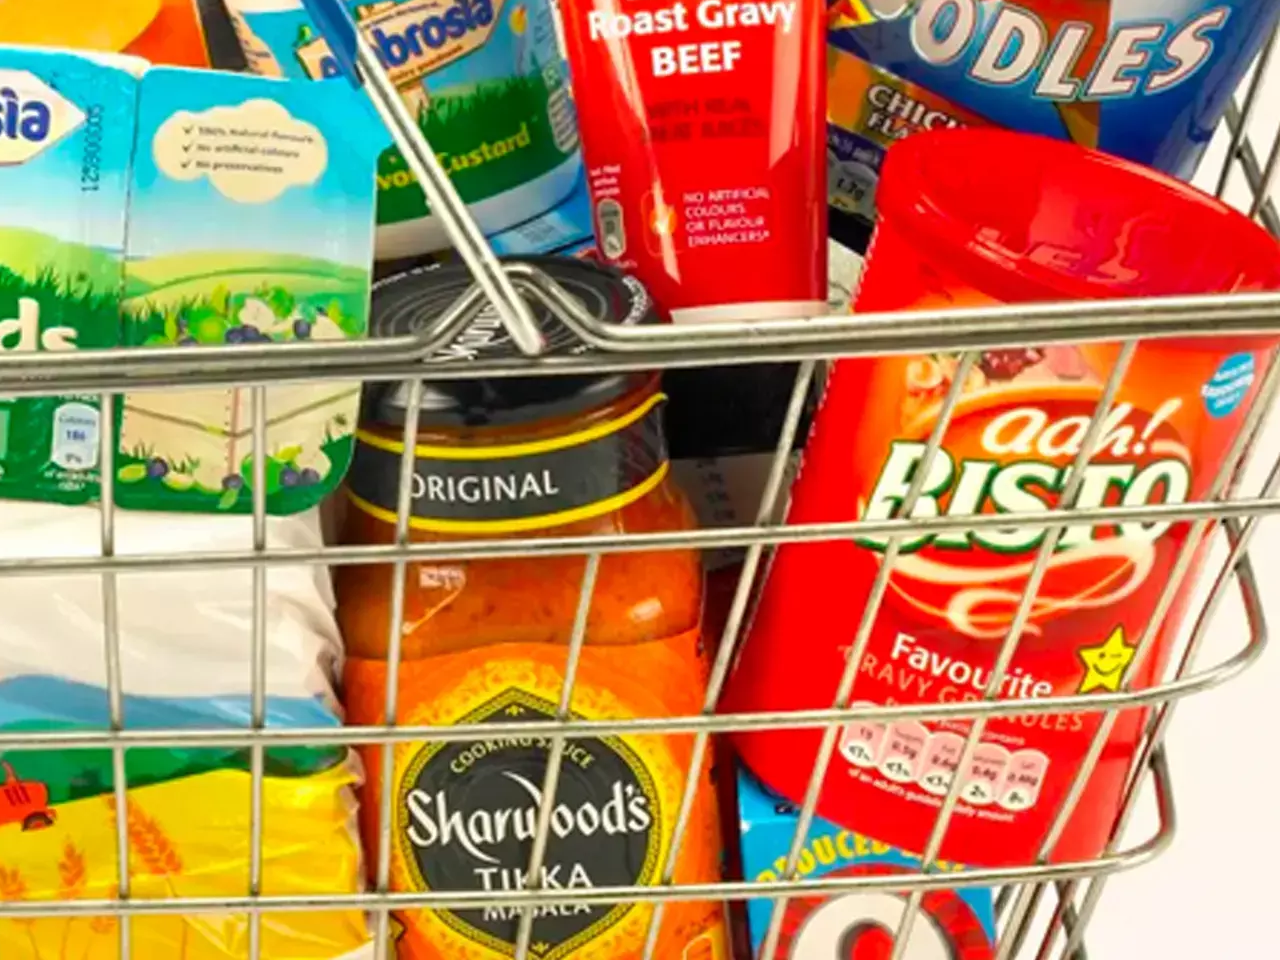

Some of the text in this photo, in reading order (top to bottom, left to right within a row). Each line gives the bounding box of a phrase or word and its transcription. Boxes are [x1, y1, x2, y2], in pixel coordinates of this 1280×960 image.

[588, 1, 689, 41] Roast
[651, 41, 743, 77] BEEF
[683, 192, 705, 203] NO
[685, 203, 746, 219] COLOURS
[686, 215, 765, 232] OR FLAVOUR
[981, 397, 1183, 459] aah!
[408, 469, 560, 503] ORIGINAL
[853, 440, 1193, 558] BISTO
[890, 631, 1054, 700] Favourite
[406, 770, 653, 864] Sharwood's
[473, 861, 594, 892] TIKKA
